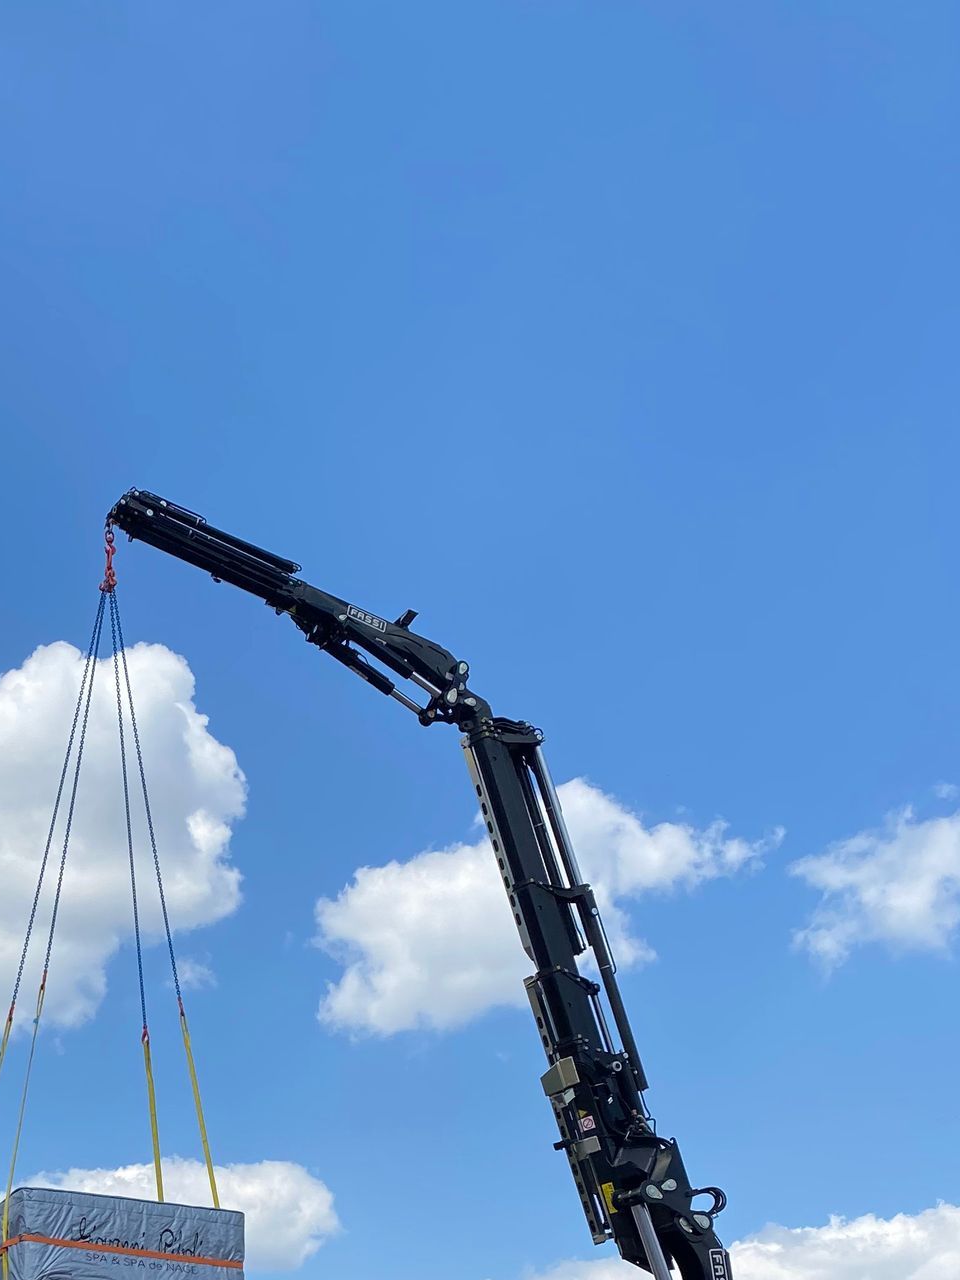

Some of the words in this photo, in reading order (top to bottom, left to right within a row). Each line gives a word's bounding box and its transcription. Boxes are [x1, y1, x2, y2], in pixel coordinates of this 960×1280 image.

[351, 608, 383, 629] FASSI
[86, 1252, 108, 1263] SPA
[111, 1256, 120, 1265] &
[123, 1257, 146, 1268] SPA
[149, 1261, 163, 1270] de
[166, 1262, 199, 1275] NAGE
